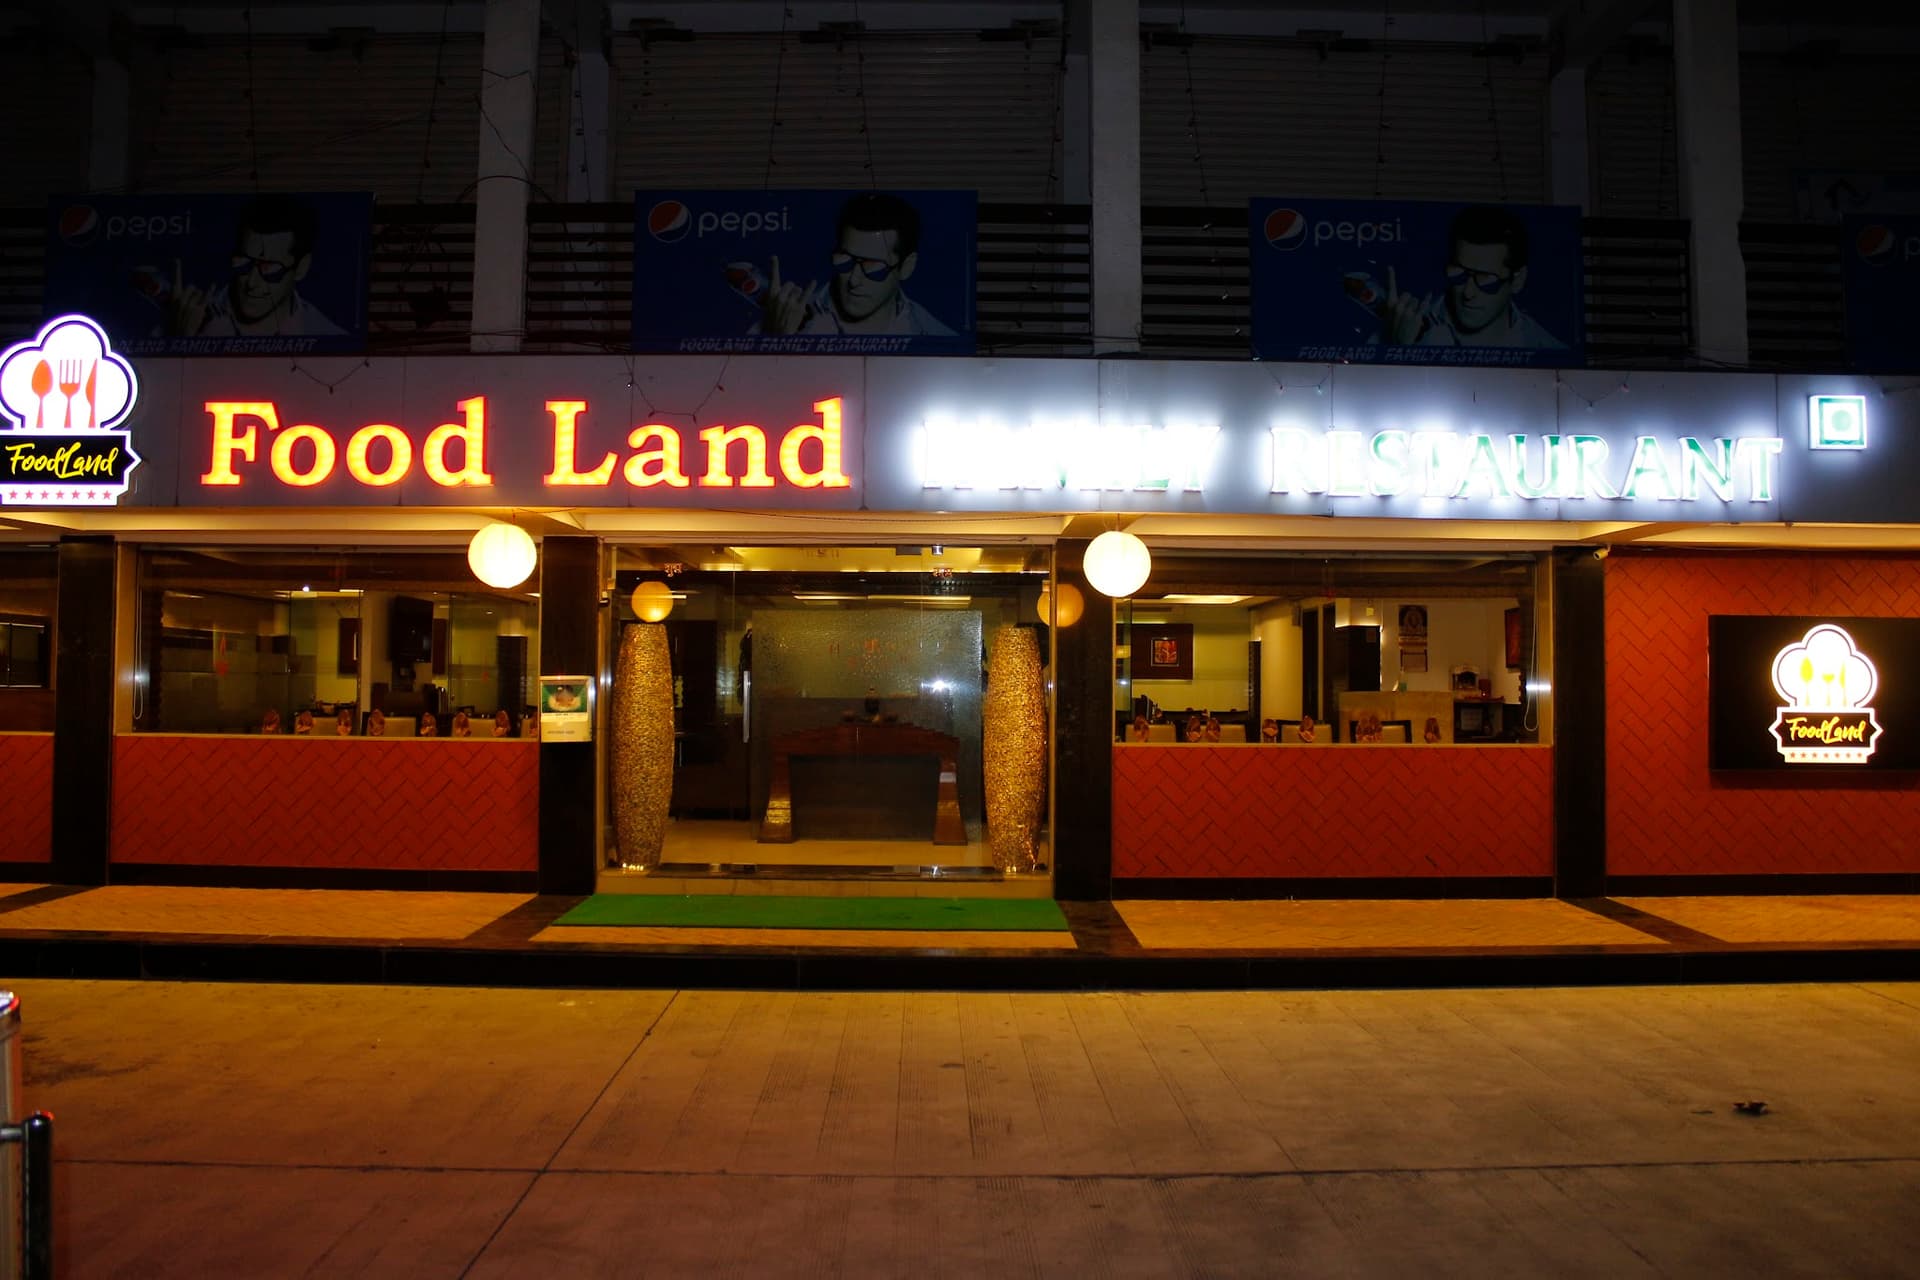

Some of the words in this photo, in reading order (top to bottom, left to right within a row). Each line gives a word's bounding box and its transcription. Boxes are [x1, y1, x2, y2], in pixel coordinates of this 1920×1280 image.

[106, 208, 192, 241] pepsi
[698, 205, 788, 239] pepsi
[1313, 216, 1402, 248] pepsi
[223, 337, 319, 352] RESTAURANT
[679, 337, 756, 352] FOODLAND
[758, 337, 815, 352] FAMILY
[815, 337, 912, 352] RESTAURANT
[1296, 345, 1376, 361] FOODLAND
[1383, 346, 1437, 362] FAMILY
[1437, 348, 1536, 365] RESTAURANT
[200, 396, 494, 487] Food
[543, 397, 852, 488] Land
[5, 441, 119, 478] FoodLand
[1270, 426, 1784, 502] RESTAURANT
[1785, 716, 1866, 743] FoodLand
